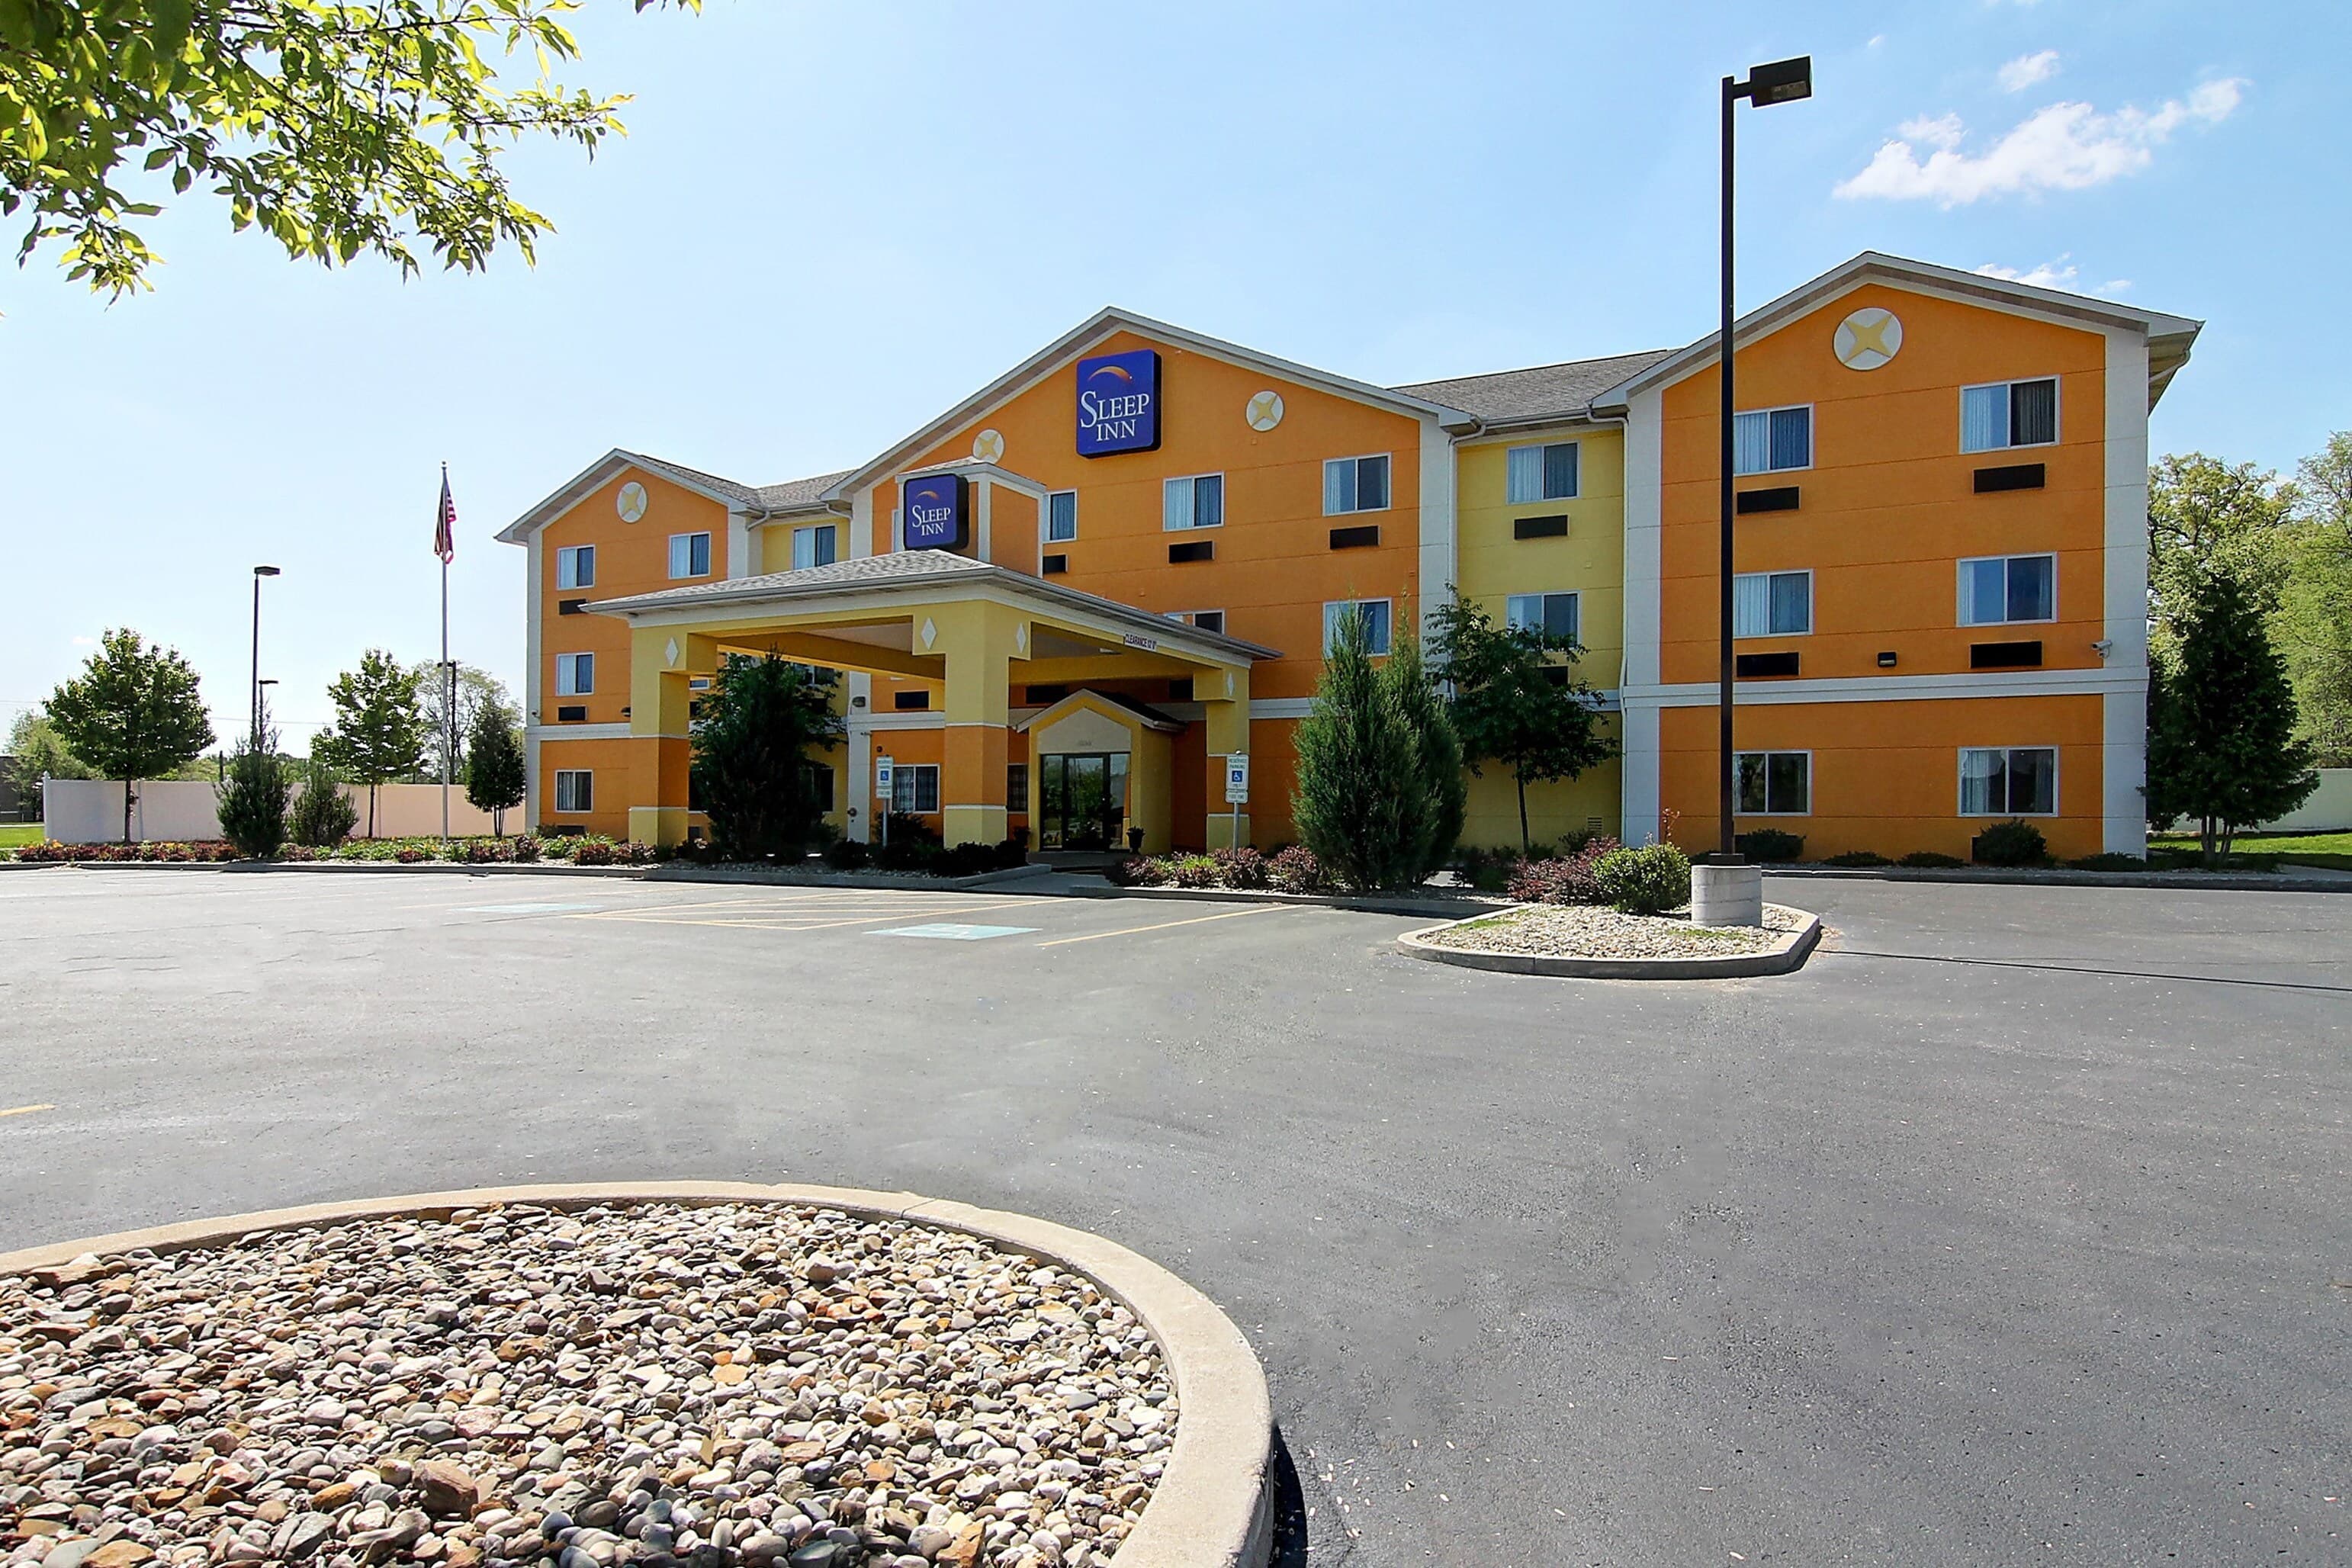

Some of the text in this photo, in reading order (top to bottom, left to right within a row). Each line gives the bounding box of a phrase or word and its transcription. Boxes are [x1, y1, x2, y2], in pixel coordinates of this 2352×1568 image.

[1080, 390, 1150, 428] SLEEP
[1096, 419, 1136, 442] INN
[911, 505, 951, 528] SLEEP
[921, 522, 944, 536] INN
[1125, 633, 1147, 647] CLEARANCE
